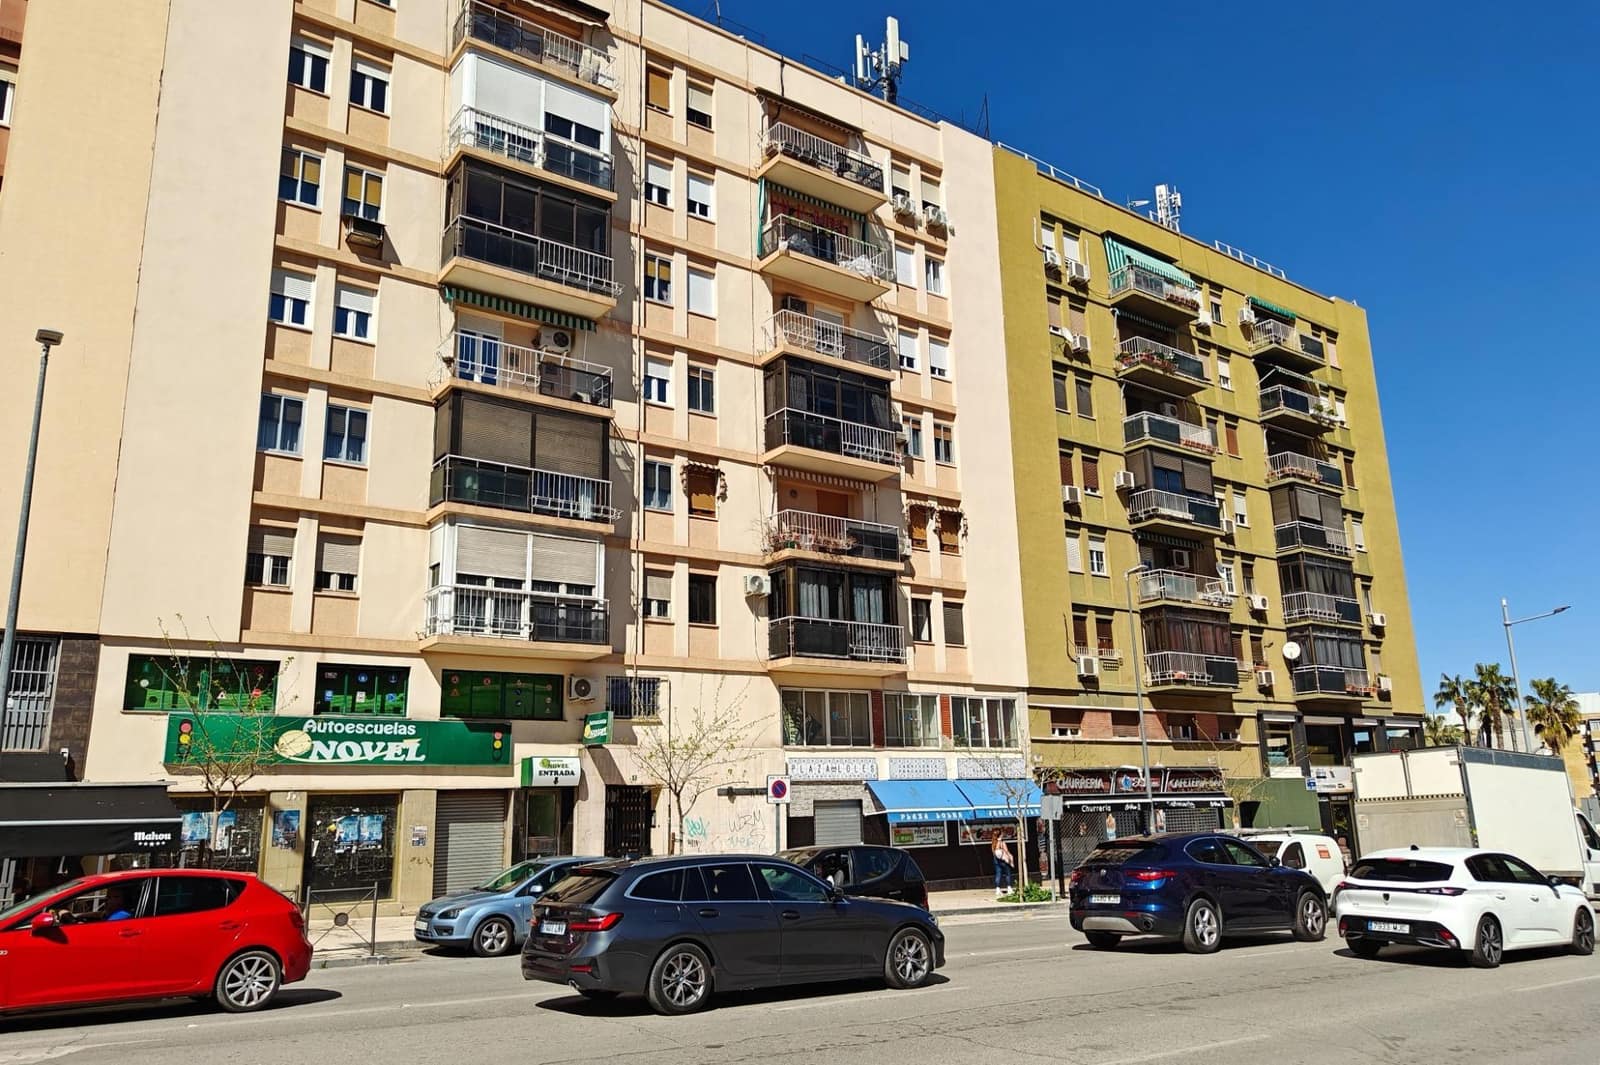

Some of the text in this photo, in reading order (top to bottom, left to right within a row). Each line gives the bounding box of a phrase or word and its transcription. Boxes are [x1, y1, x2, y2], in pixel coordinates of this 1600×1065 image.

[302, 719, 416, 736] Autoescuelas
[309, 738, 426, 762] NOVEL
[791, 763, 830, 774] PLAZA
[837, 763, 875, 773] LOLES
[1056, 777, 1105, 790] CHURRERIA
[134, 831, 172, 841] Mahou
